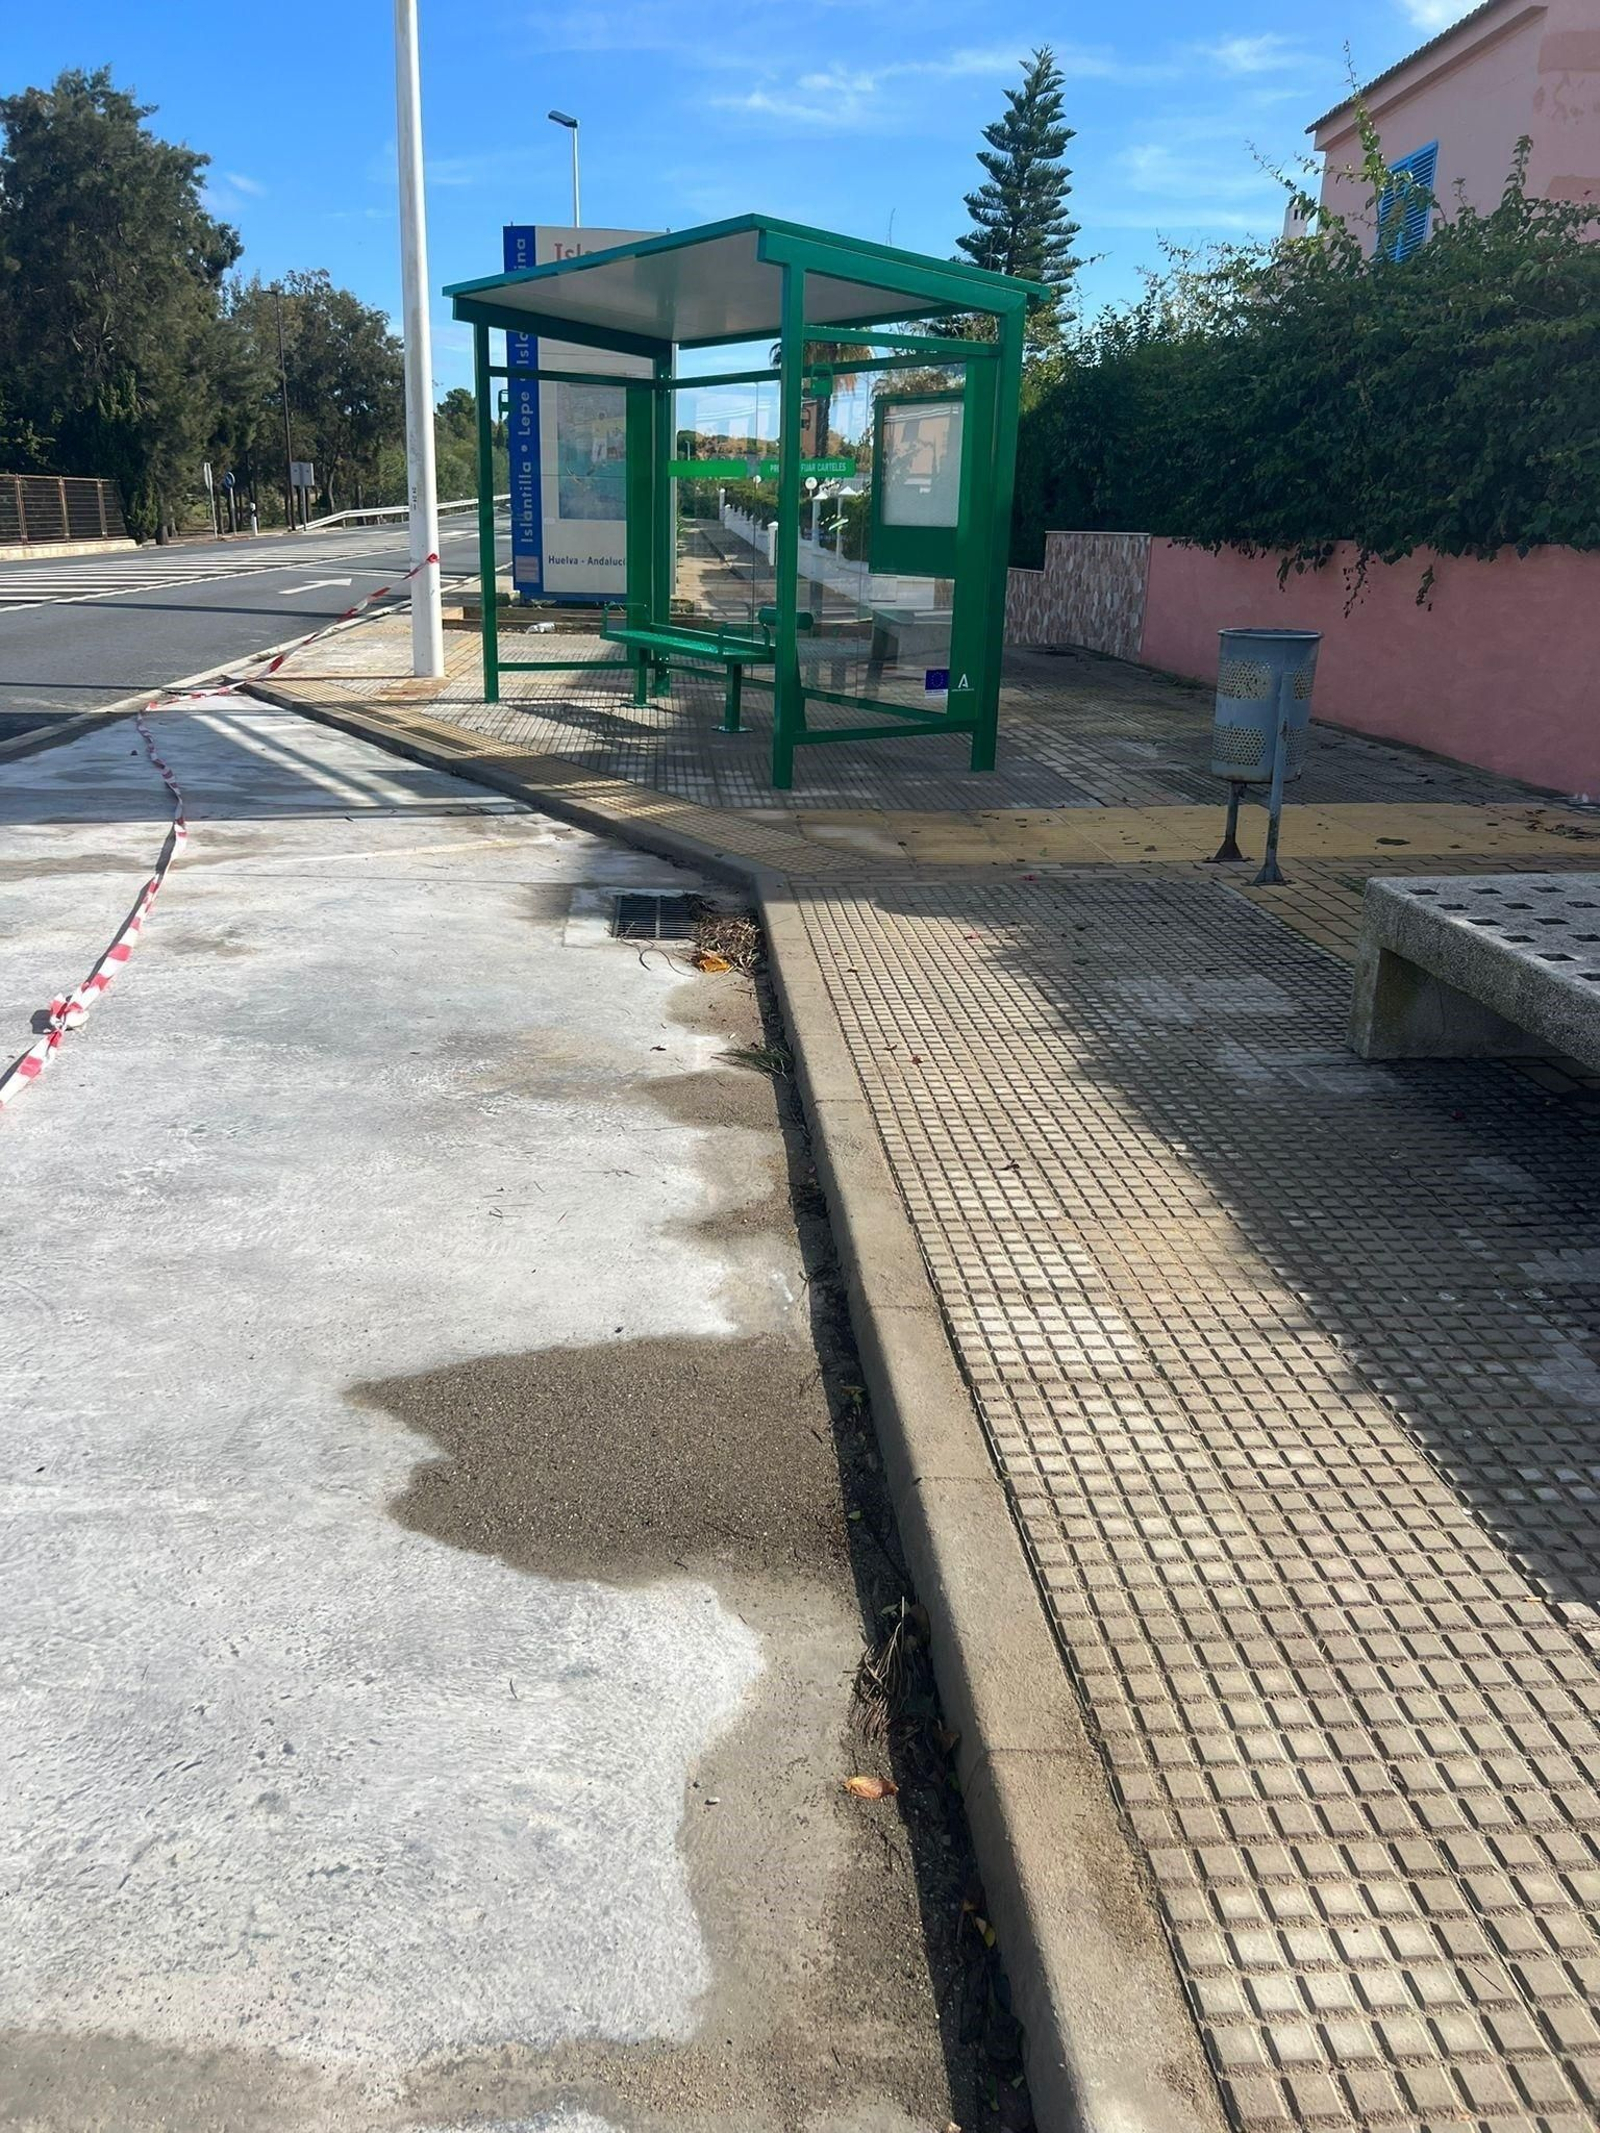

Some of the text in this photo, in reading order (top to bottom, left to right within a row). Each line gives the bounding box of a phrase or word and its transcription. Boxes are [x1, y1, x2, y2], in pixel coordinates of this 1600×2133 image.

[518, 391, 533, 435] Lepe
[817, 462, 847, 472] CARTELES
[519, 462, 533, 542] Islantilla
[548, 555, 578, 565] Huelva
